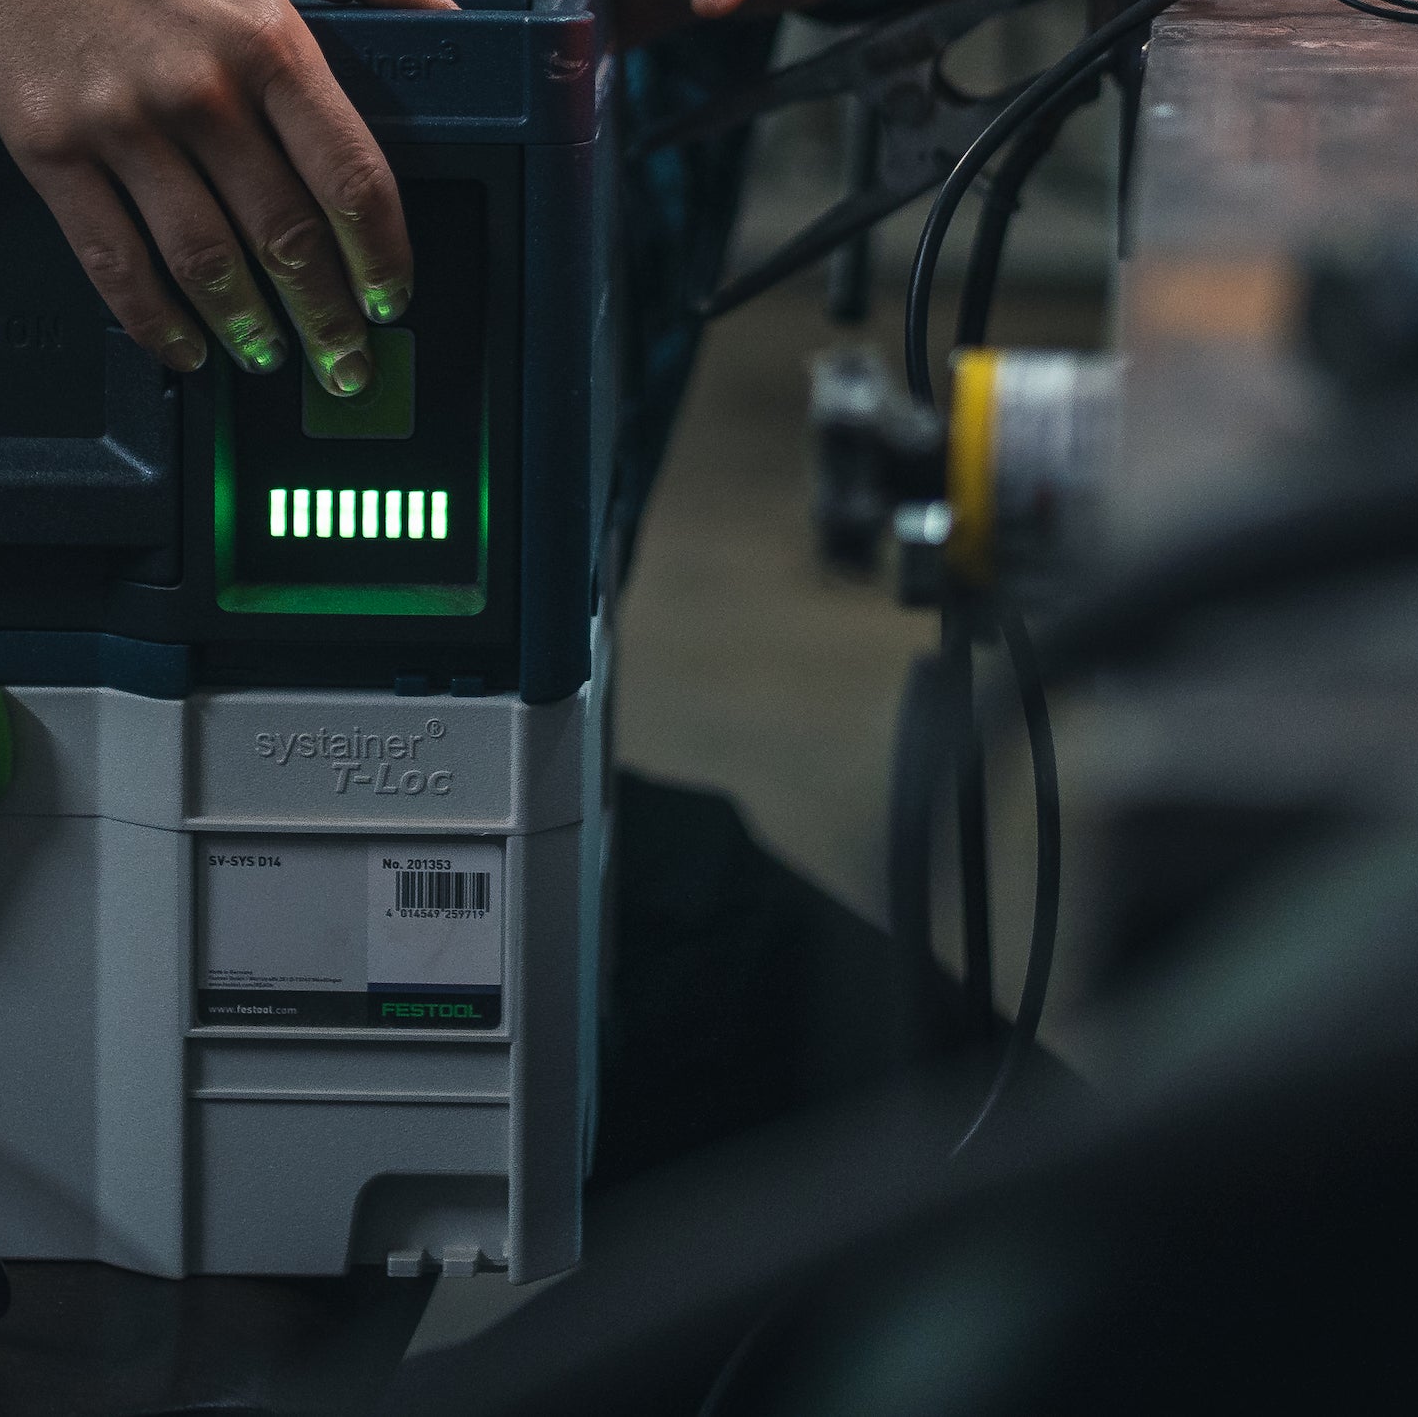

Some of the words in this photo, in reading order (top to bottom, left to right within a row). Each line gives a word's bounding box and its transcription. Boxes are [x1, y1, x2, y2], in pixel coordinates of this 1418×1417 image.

[331, 761, 455, 795] T-Loc
[208, 855, 255, 867] SV-SYS
[258, 856, 282, 868] D14
[382, 859, 404, 871] No.
[407, 859, 452, 871] 201353
[386, 908, 393, 918] 4
[400, 908, 441, 919] 014549
[444, 909, 486, 920] 259719
[208, 1004, 298, 1016] www.festool.com
[381, 1002, 483, 1019] FESTOOL
